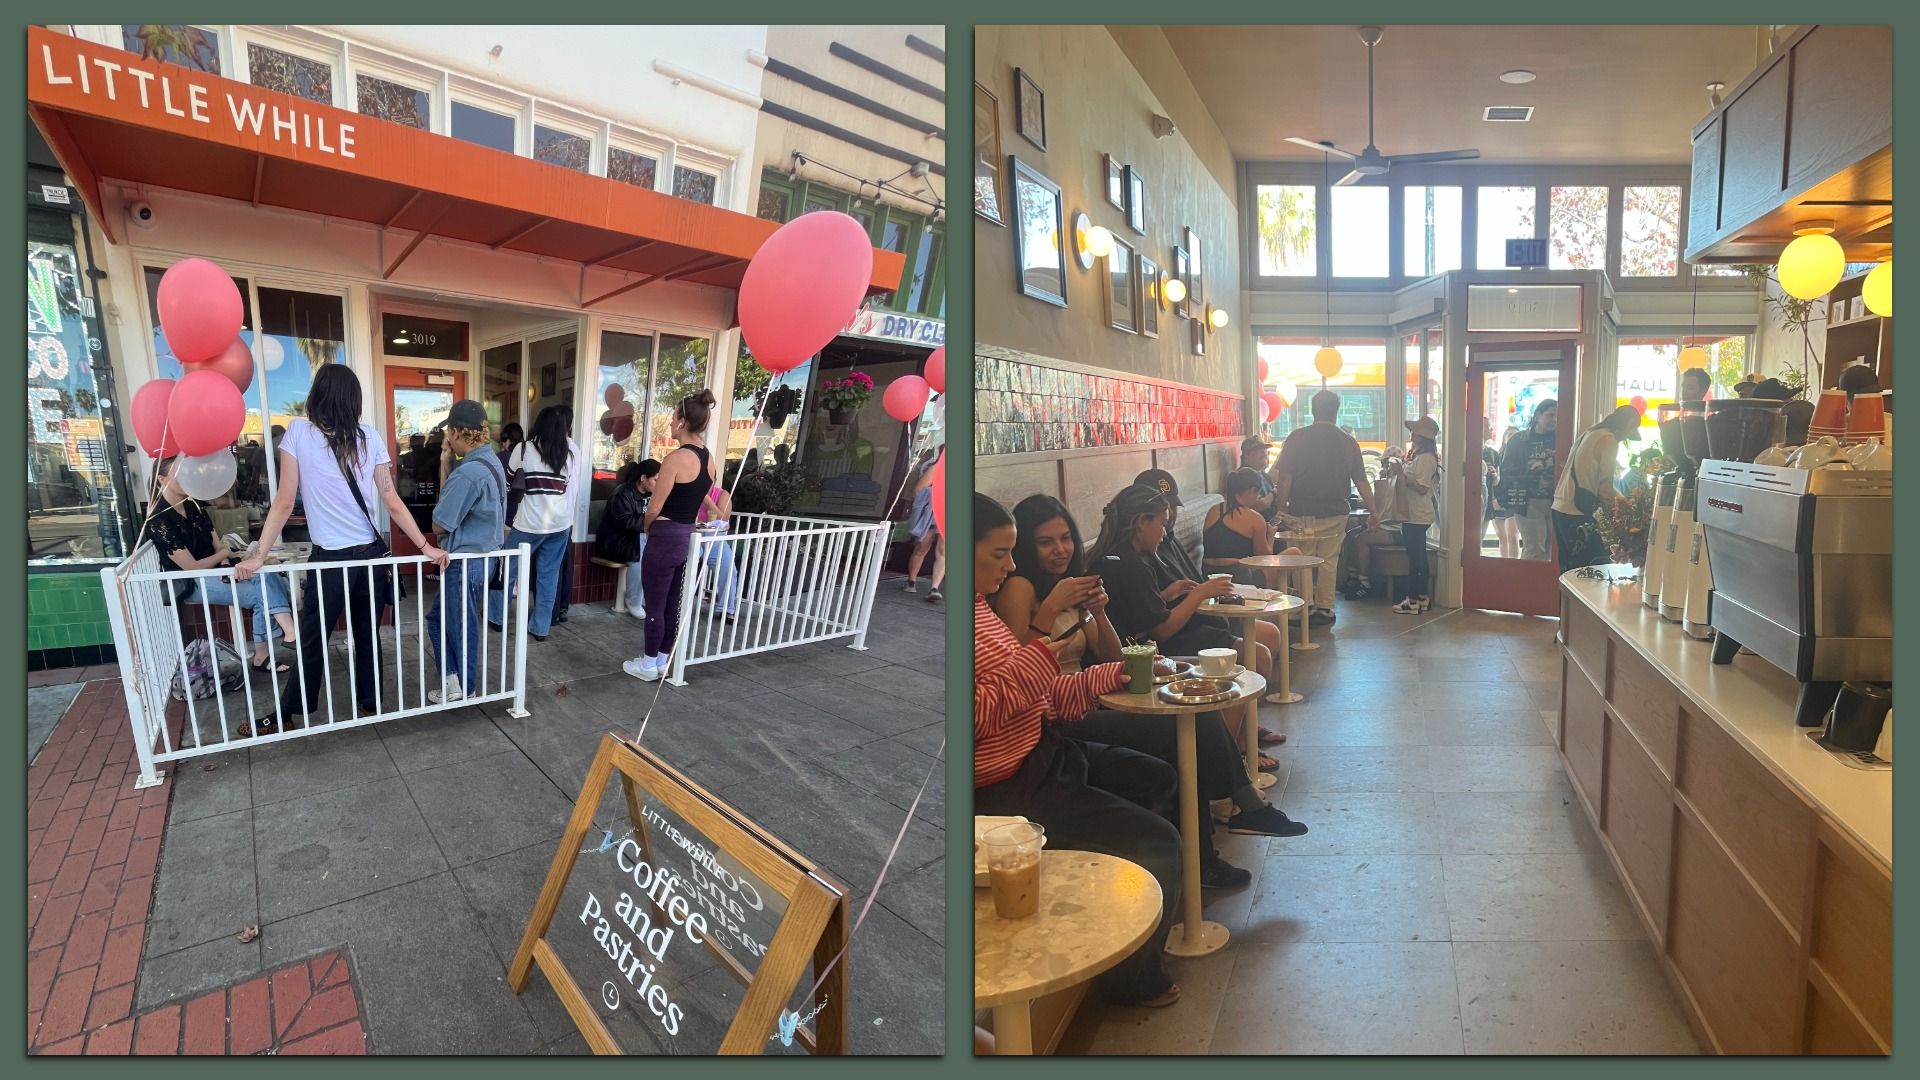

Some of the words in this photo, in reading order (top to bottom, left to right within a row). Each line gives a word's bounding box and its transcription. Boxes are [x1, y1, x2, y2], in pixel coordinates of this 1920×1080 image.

[42, 44, 210, 124] LITTLE
[226, 92, 356, 159] WHILE
[1511, 241, 1543, 265] EXIT
[411, 333, 436, 346] 3019
[882, 315, 920, 339] DRY
[1616, 378, 1667, 392] HAUL
[641, 805, 682, 842] LITTLE
[681, 837, 726, 880] WHILE
[616, 838, 708, 944] Coffee
[579, 892, 684, 1036] Pastries
[614, 892, 675, 964] and
